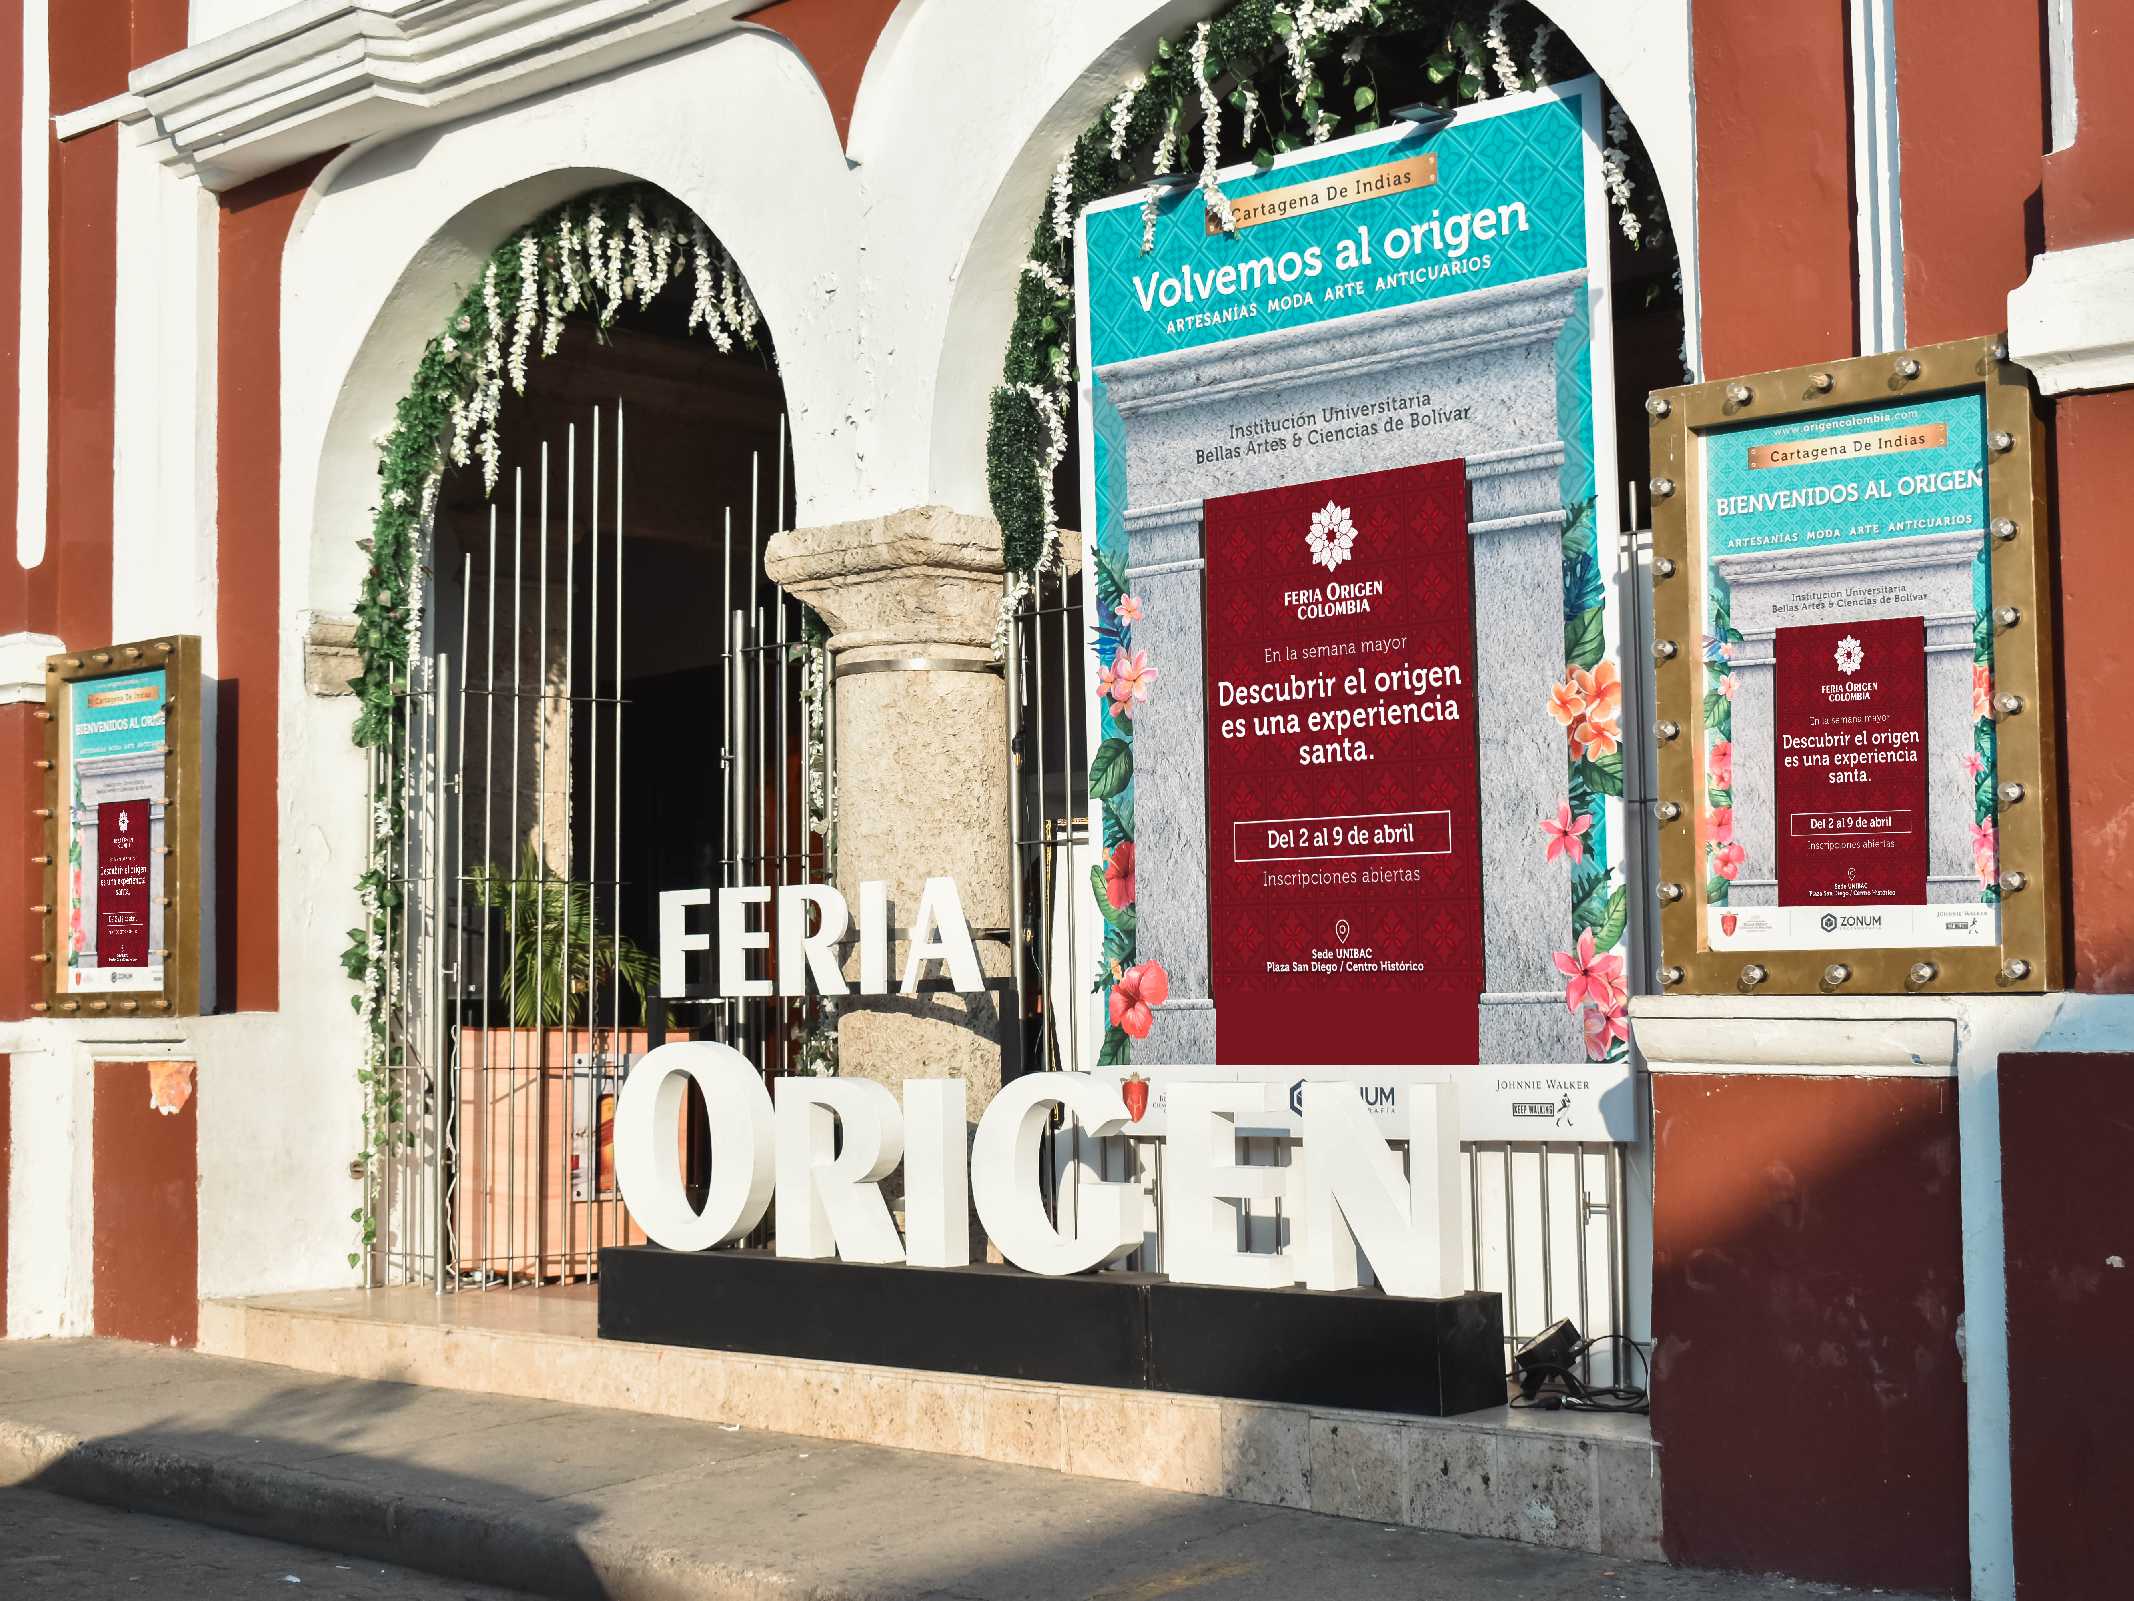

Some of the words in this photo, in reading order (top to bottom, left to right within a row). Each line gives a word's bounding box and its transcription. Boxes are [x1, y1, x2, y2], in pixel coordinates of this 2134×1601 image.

[1231, 193, 1319, 223] Cartagena
[1327, 186, 1348, 201] De
[1356, 171, 1411, 195] Indias
[1132, 245, 1322, 312] Volvemos
[1335, 226, 1372, 271] al
[1383, 200, 1529, 258] origen
[1166, 303, 1258, 335] ARTESANÍAS
[1268, 291, 1314, 312] MODA
[1324, 281, 1365, 301] ARTE
[1375, 255, 1492, 290] ANTICUARIOS
[1229, 411, 1316, 440] Institución
[1322, 394, 1431, 424] Universitaria
[1774, 410, 1918, 436] www.origencolombia.com
[1195, 444, 1241, 464] Bellas
[1246, 438, 1287, 455] Artes
[1293, 433, 1302, 448] &
[1307, 423, 1378, 445] Ciencias
[1383, 416, 1404, 431] de
[1410, 406, 1471, 428] Bolívar
[1770, 444, 1847, 463] Cartagena
[1853, 440, 1872, 452] De
[1878, 434, 1925, 449] Indias
[1716, 482, 1858, 516] BIENVENIDOS
[1864, 480, 1892, 499] AL
[1897, 468, 1983, 497] ORIGEN
[1806, 528, 1841, 540] MODA
[1849, 524, 1880, 537] ARTE
[1888, 514, 1973, 532] ANTICUARIOS
[1284, 589, 1323, 606] FERIA
[1326, 580, 1383, 600] ORIGEN
[1880, 595, 1891, 604] de
[1297, 599, 1370, 620] COLOMBIA
[1265, 649, 1281, 663] En
[1286, 647, 1297, 660] la
[1302, 641, 1356, 659] semana
[1361, 635, 1407, 653] mayor
[1218, 672, 1336, 706] Descubrir
[1344, 668, 1367, 695] el
[1374, 663, 1462, 695] origen
[1821, 685, 1844, 694] FERIA
[1845, 681, 1878, 692] ORIGEN
[1828, 692, 1871, 702] COLOMBIA
[1222, 717, 1246, 738] es
[1254, 713, 1300, 736] una
[1307, 695, 1459, 735] experiencia
[1300, 737, 1375, 765] santa.
[1782, 731, 1850, 749] Descubrir
[1855, 730, 1867, 745] el
[1872, 729, 1920, 747] origen
[1784, 755, 1799, 767] es
[1803, 754, 1829, 766] una
[1834, 747, 1917, 767] experiencia
[1828, 769, 1872, 784] santa.
[1810, 818, 1825, 829] Del
[1828, 818, 1833, 828] 2
[1836, 817, 1845, 828] al
[1847, 816, 1853, 828] 9
[1855, 817, 1867, 828] de
[1870, 816, 1892, 827] abril
[1268, 829, 1294, 849] Del
[1299, 828, 1309, 847] 2
[1313, 827, 1328, 846] al
[1333, 826, 1343, 845] 9
[1348, 826, 1368, 845] de
[1374, 823, 1414, 844] abril
[1263, 869, 1357, 888] Inscripciones
[1362, 866, 1421, 883] abiertas
[1840, 916, 1882, 926] ZONUM
[659, 876, 986, 998] FERIA
[1312, 948, 1333, 959] Sede
[1336, 948, 1372, 958] UNIBAC
[1267, 961, 1289, 972] Plaza
[1292, 961, 1309, 971] San
[1311, 961, 1338, 974] Diego
[1346, 961, 1377, 971] Centro
[1380, 960, 1424, 971] Histórico
[1496, 1080, 1541, 1092] JOHNNIE
[1546, 1079, 1589, 1089] WALKER
[1514, 1105, 1526, 1114] KEEP
[613, 1040, 1465, 1300] ORIGEN
